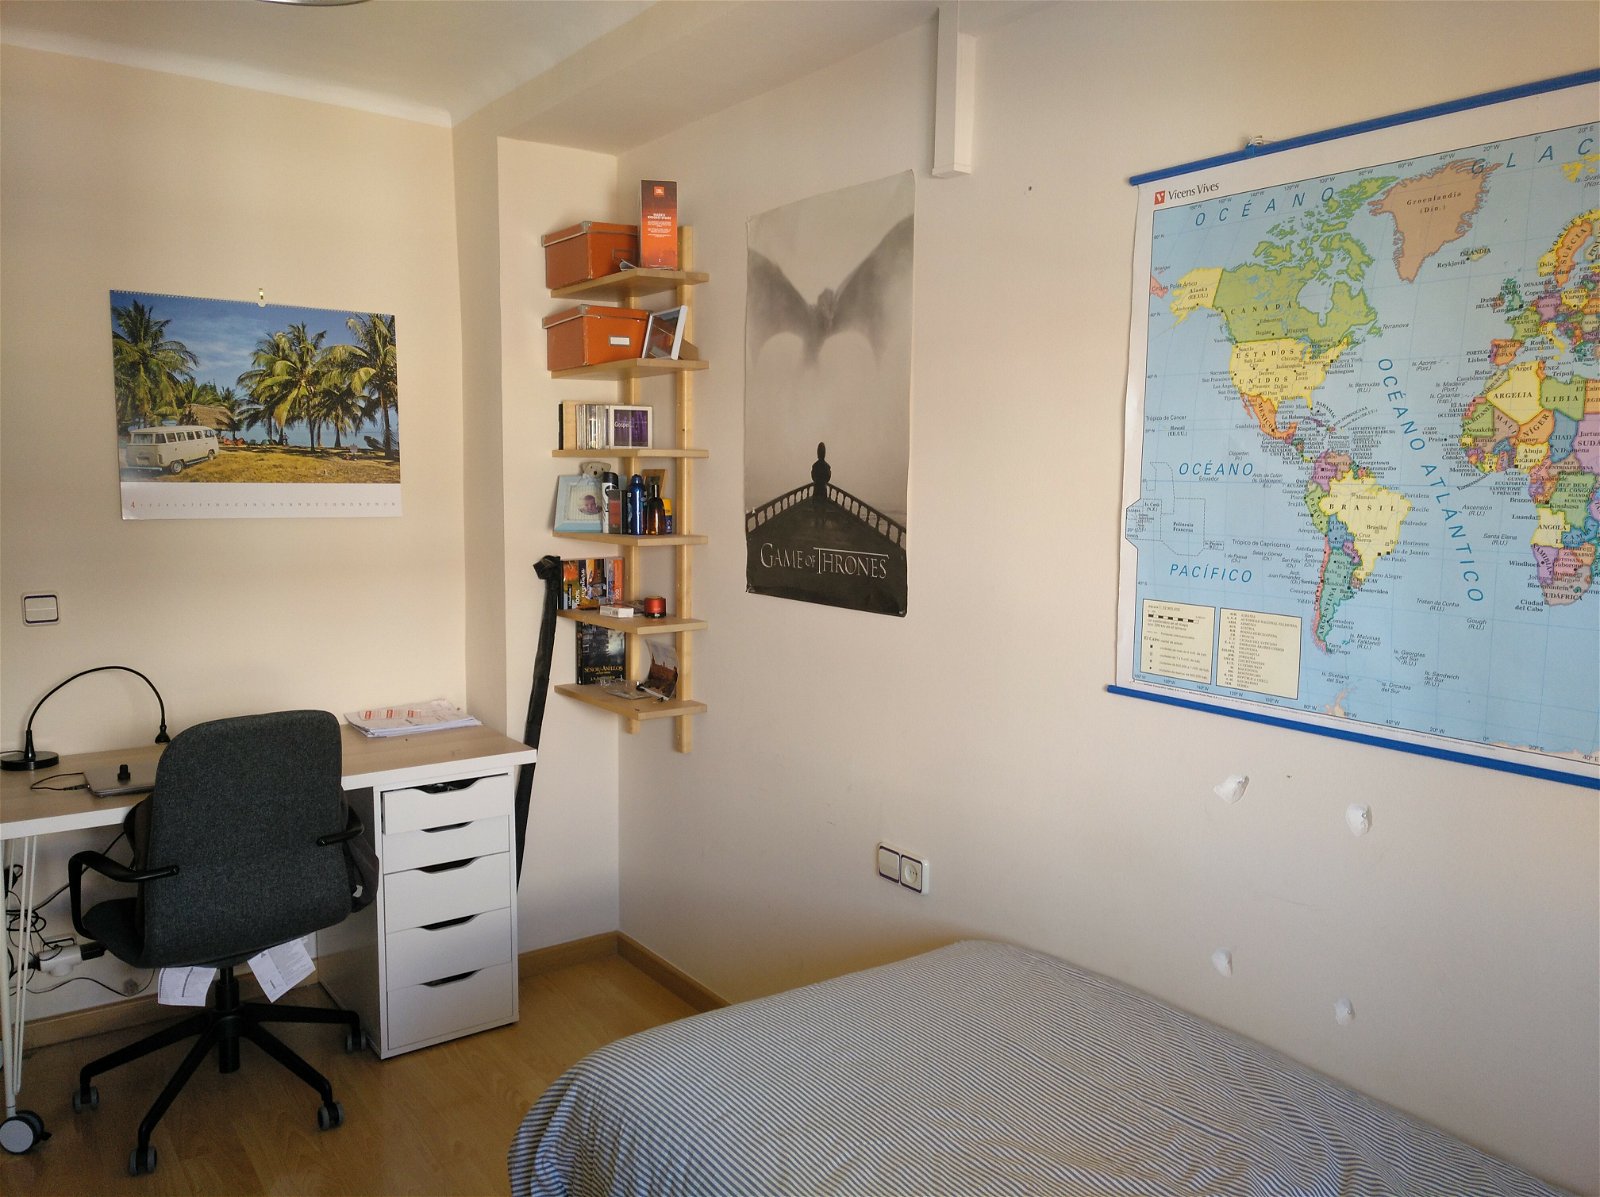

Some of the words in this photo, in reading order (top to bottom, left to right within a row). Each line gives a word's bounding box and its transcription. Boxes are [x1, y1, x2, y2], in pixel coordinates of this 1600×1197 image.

[1168, 189, 1196, 200] Vicens
[1198, 182, 1220, 194] Vives
[1406, 192, 1462, 205] Groenlandia
[1195, 187, 1334, 226] OCÉANO
[1561, 227, 1587, 264] SUECIA
[1236, 350, 1294, 359] ESTADOS
[1240, 376, 1288, 384] UNIDOS
[1179, 460, 1253, 476] OCÉANO
[1378, 358, 1425, 451] OCÉANO
[1421, 464, 1484, 602] ATLÁNTICO
[760, 542, 802, 568] GAME
[805, 554, 816, 567] OF
[813, 546, 890, 578] THRONES
[1170, 564, 1252, 582] PACÍFICO
[1432, 671, 1460, 680] Sandwich
